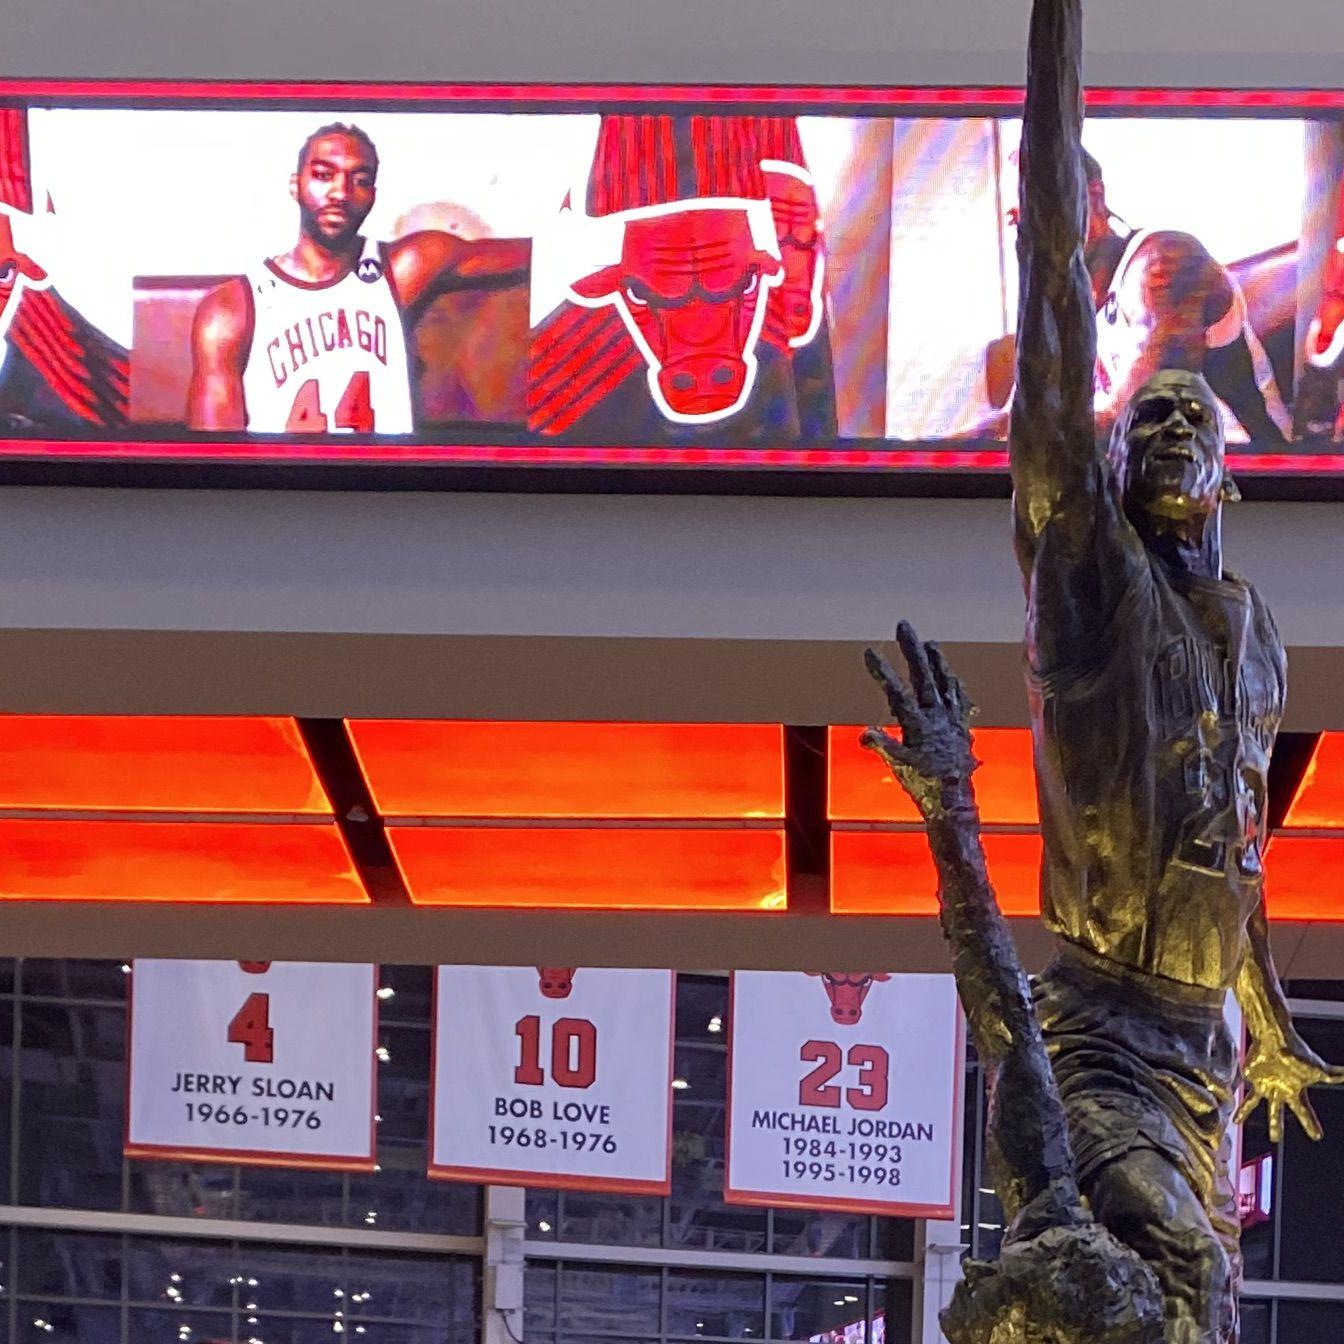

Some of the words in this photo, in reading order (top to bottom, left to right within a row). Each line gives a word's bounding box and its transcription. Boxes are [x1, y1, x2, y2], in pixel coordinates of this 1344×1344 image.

[266, 308, 387, 389] CHICAGO
[285, 371, 375, 433] 44
[227, 992, 274, 1064] 4
[514, 1014, 597, 1089] 10
[171, 1072, 242, 1095] JERRY
[252, 1077, 335, 1101] SLOAN
[799, 1039, 889, 1112] 23
[186, 1102, 322, 1130] 1966-1976
[494, 1097, 544, 1119] BOB
[553, 1101, 611, 1124] LOVE
[488, 1125, 618, 1154] 1968-1976
[751, 1110, 842, 1135] MICHAEL
[847, 1118, 934, 1142] JORDAN
[783, 1137, 903, 1164] 1984-1993
[782, 1160, 902, 1187] 1995-1998
